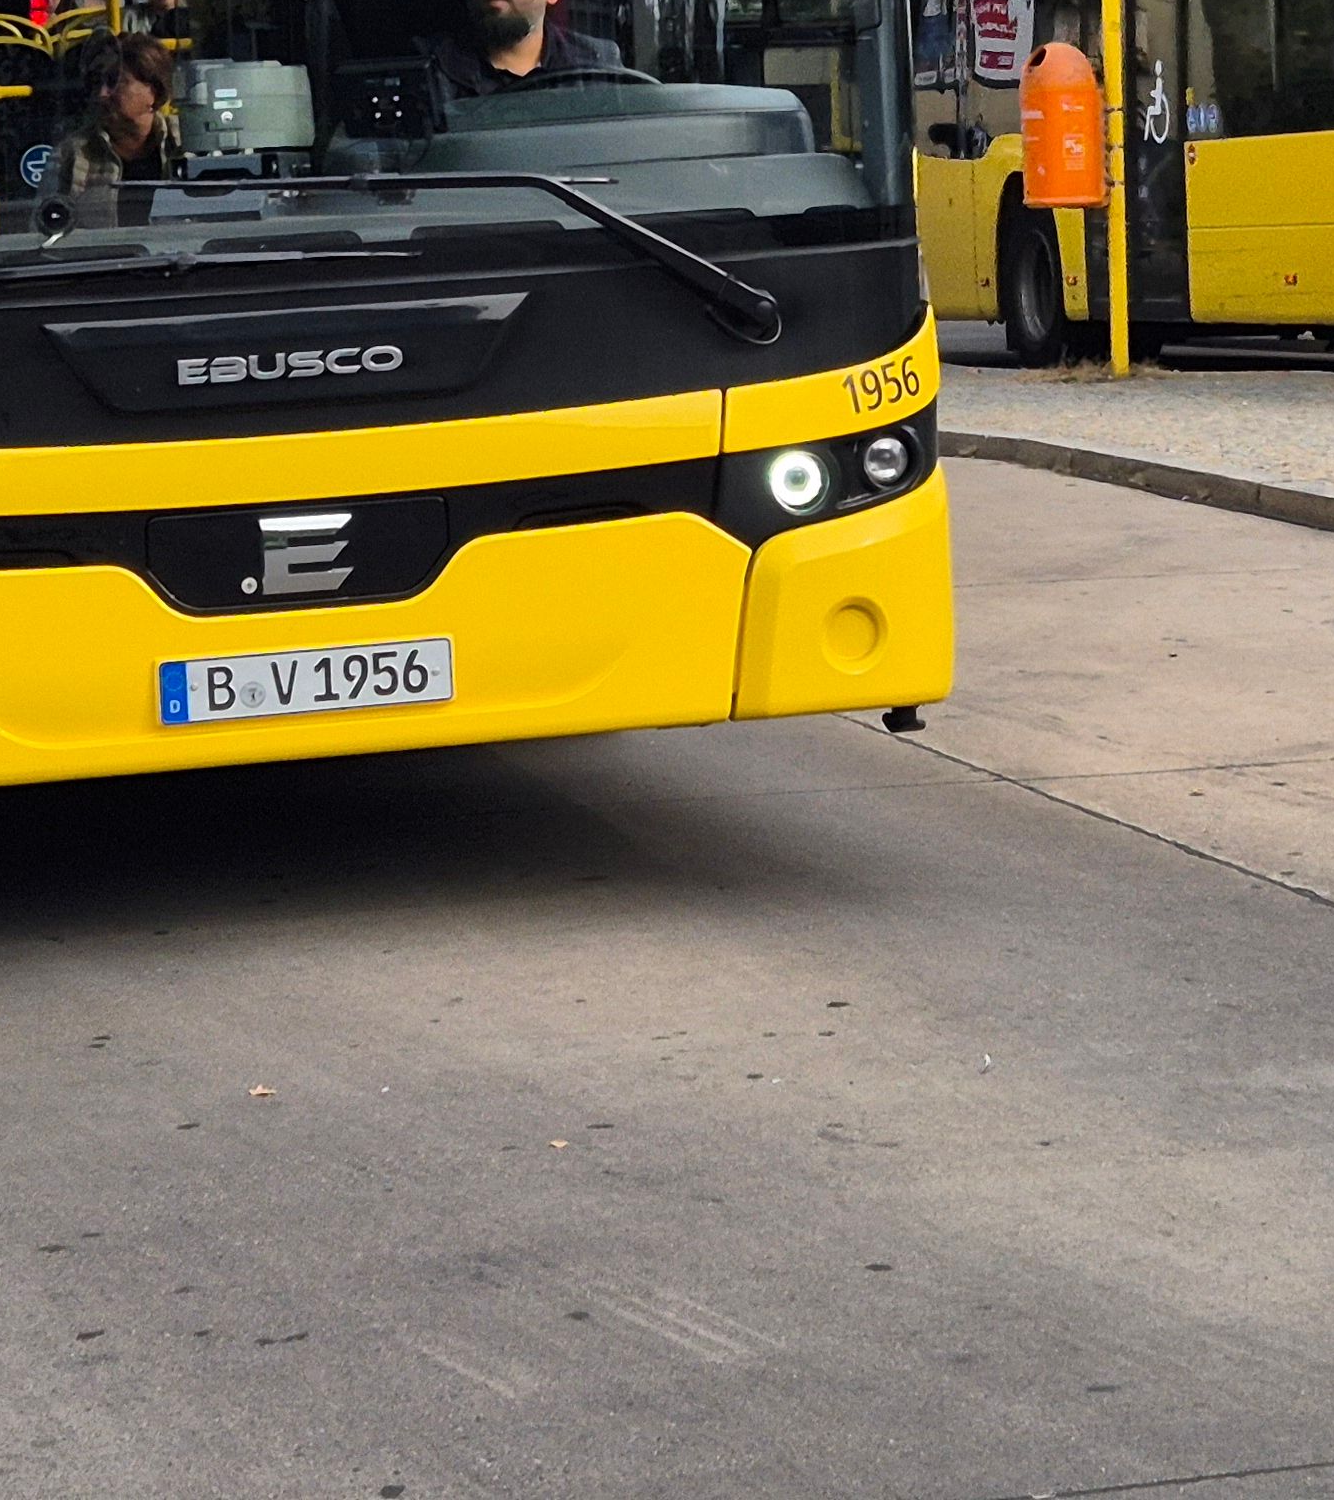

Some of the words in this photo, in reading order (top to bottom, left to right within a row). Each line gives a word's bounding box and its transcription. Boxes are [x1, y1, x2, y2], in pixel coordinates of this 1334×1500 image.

[176, 345, 404, 386] EBUSCO
[841, 355, 921, 414] 1956
[206, 665, 237, 712] B
[270, 659, 299, 706] V
[313, 648, 430, 703] 1956
